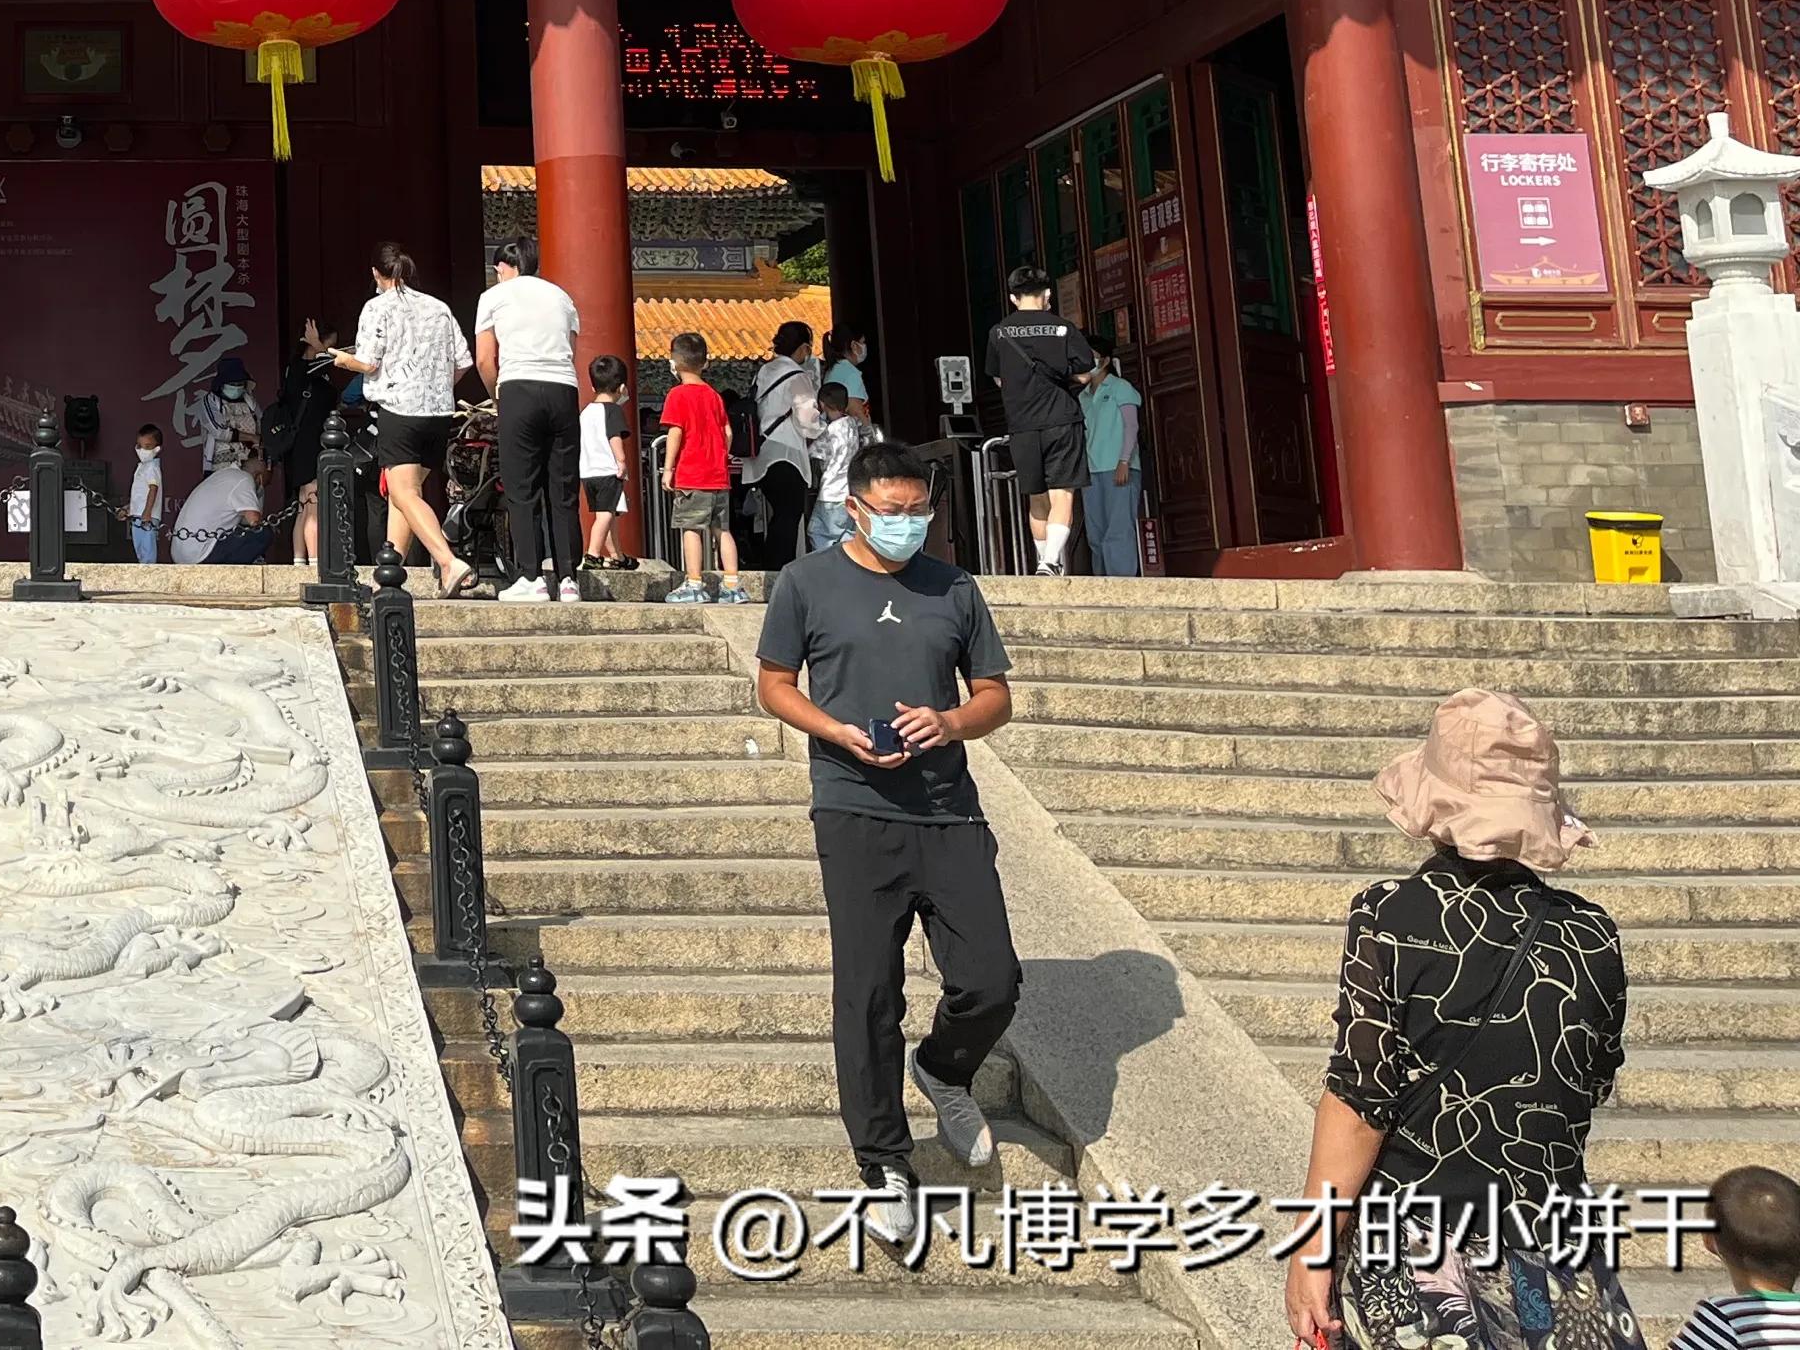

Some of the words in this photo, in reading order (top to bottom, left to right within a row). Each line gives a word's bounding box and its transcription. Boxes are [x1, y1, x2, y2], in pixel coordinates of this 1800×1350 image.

[1480, 153, 1578, 173] 行李寄存处
[1500, 174, 1562, 187] LOCKERS
[1406, 934, 1430, 946] Good
[1433, 940, 1455, 952] Luck
